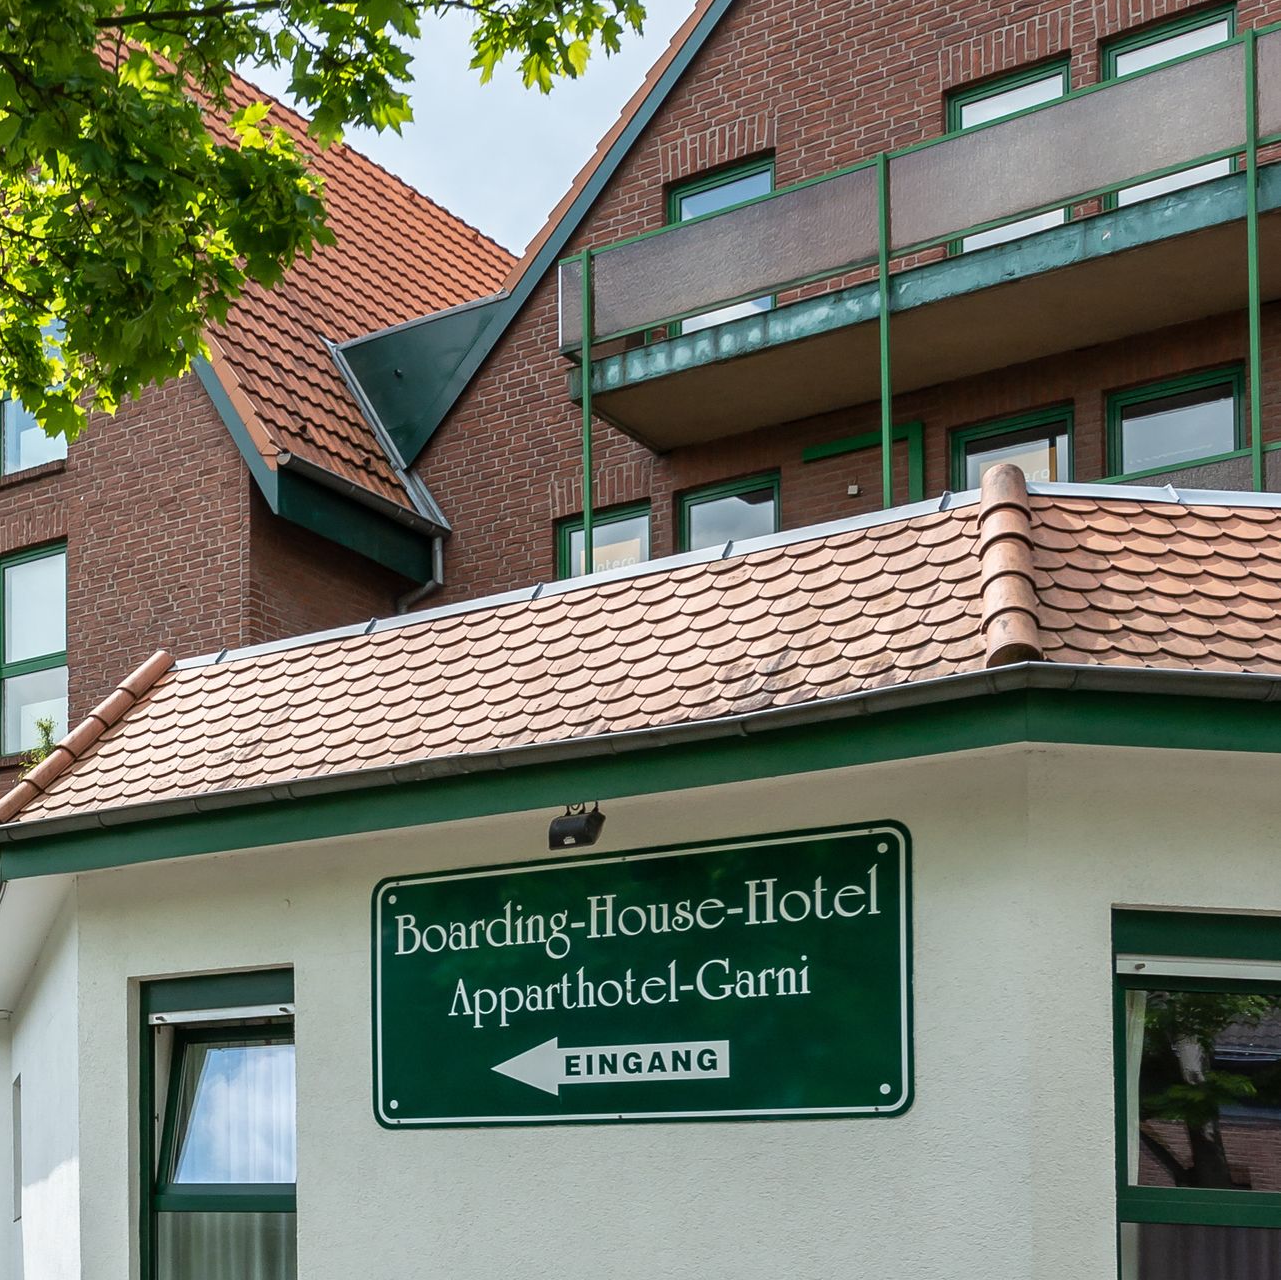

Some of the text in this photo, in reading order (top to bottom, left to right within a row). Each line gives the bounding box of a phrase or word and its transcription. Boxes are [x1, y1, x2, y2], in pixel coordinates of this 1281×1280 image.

[394, 864, 880, 958] Boarding-House-Hotel
[448, 955, 810, 1027] Apparthotel-Garni
[564, 1048, 718, 1076] EINGANG
